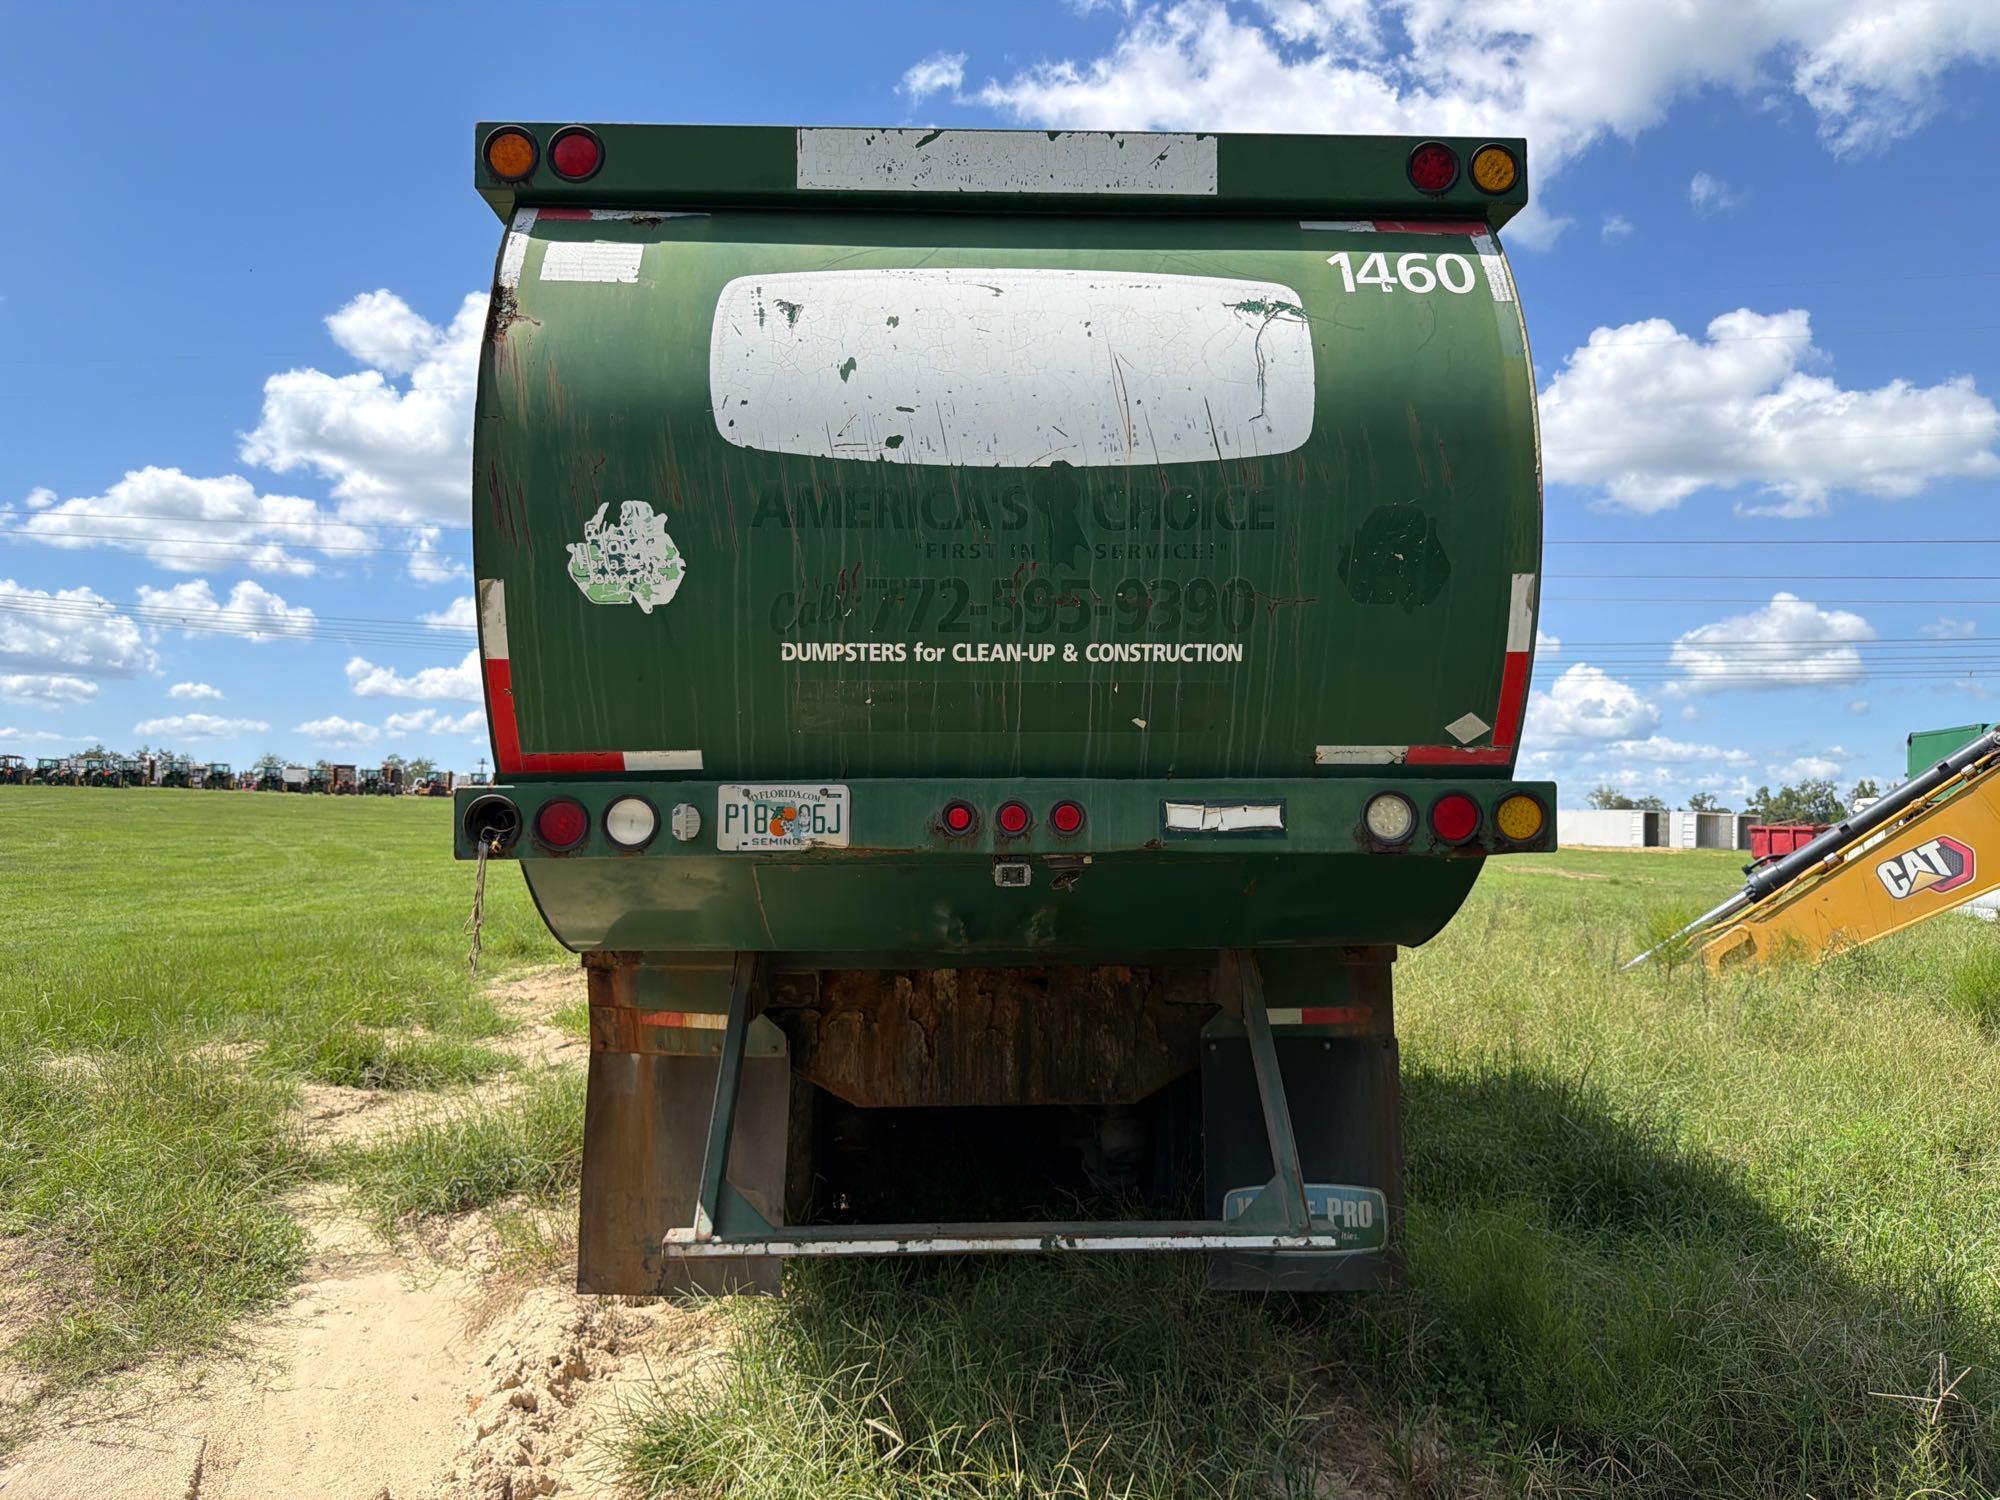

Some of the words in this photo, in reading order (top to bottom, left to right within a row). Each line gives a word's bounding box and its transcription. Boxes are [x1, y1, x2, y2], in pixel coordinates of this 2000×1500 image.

[1326, 252, 1476, 294] 1460
[751, 485, 1029, 530] AMERICA'S
[1092, 485, 1275, 531] CHOICE
[864, 576, 1257, 635] 772-595-9390
[780, 642, 907, 663] DUMPSTERS
[913, 642, 946, 663] for
[952, 642, 1056, 663] CLEAN-UP
[1062, 642, 1079, 663] &
[1085, 642, 1244, 663] CONSTRUCTION
[725, 803, 768, 834] P18
[1876, 839, 1953, 899] CAT
[1327, 1197, 1373, 1228] PRO
